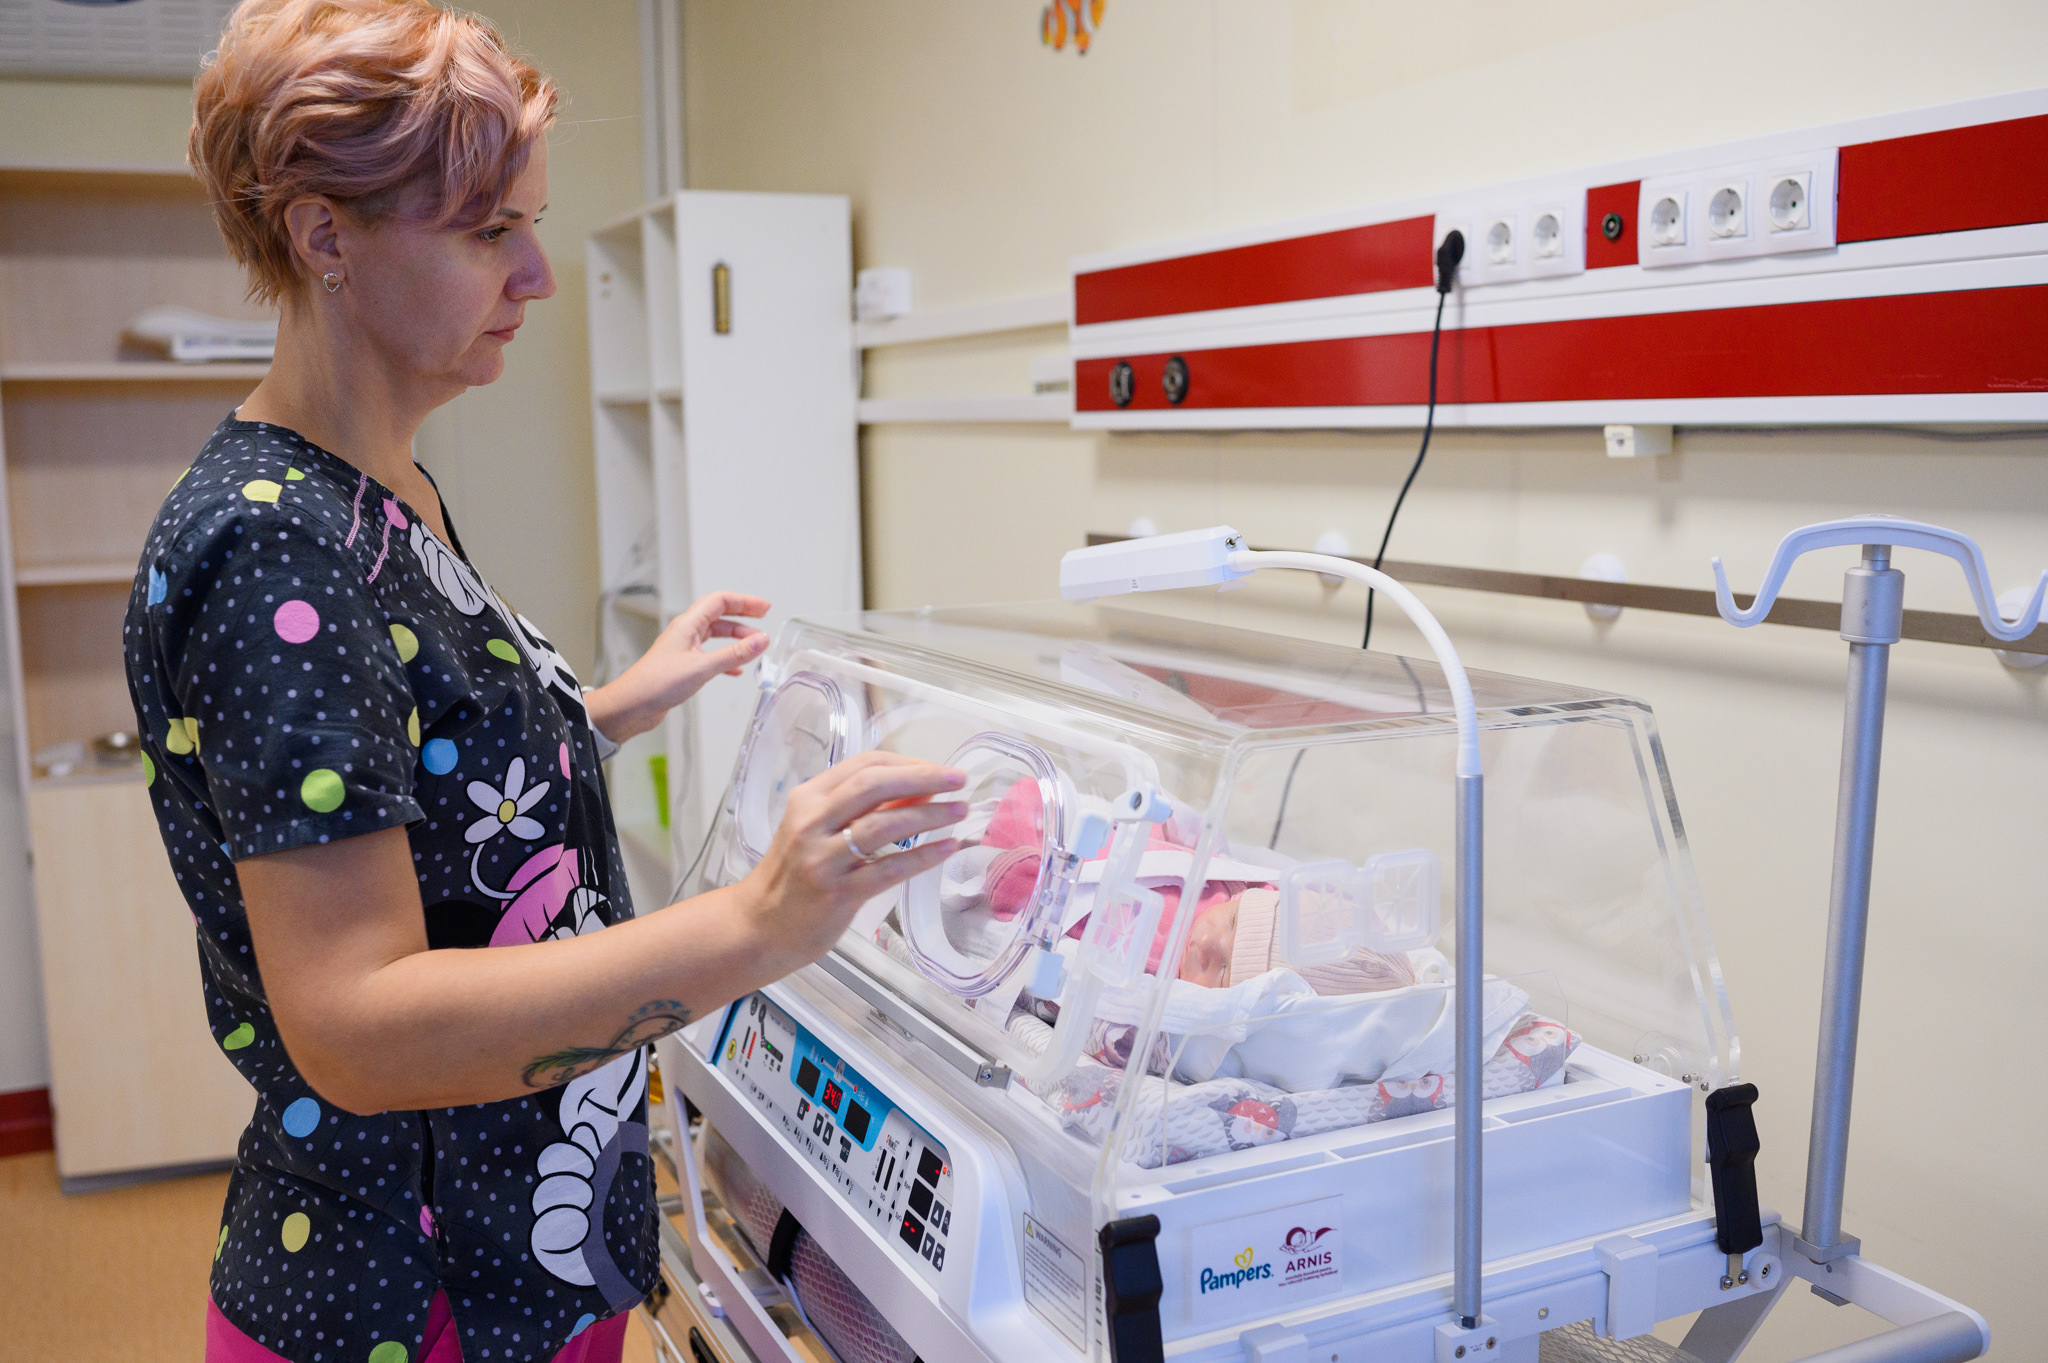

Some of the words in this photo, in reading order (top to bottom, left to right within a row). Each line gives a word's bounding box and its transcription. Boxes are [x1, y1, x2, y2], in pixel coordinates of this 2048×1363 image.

[1035, 1228, 1062, 1259] WARNING
[1285, 1251, 1332, 1274] ARNIS
[1200, 1263, 1272, 1295] Pampers
